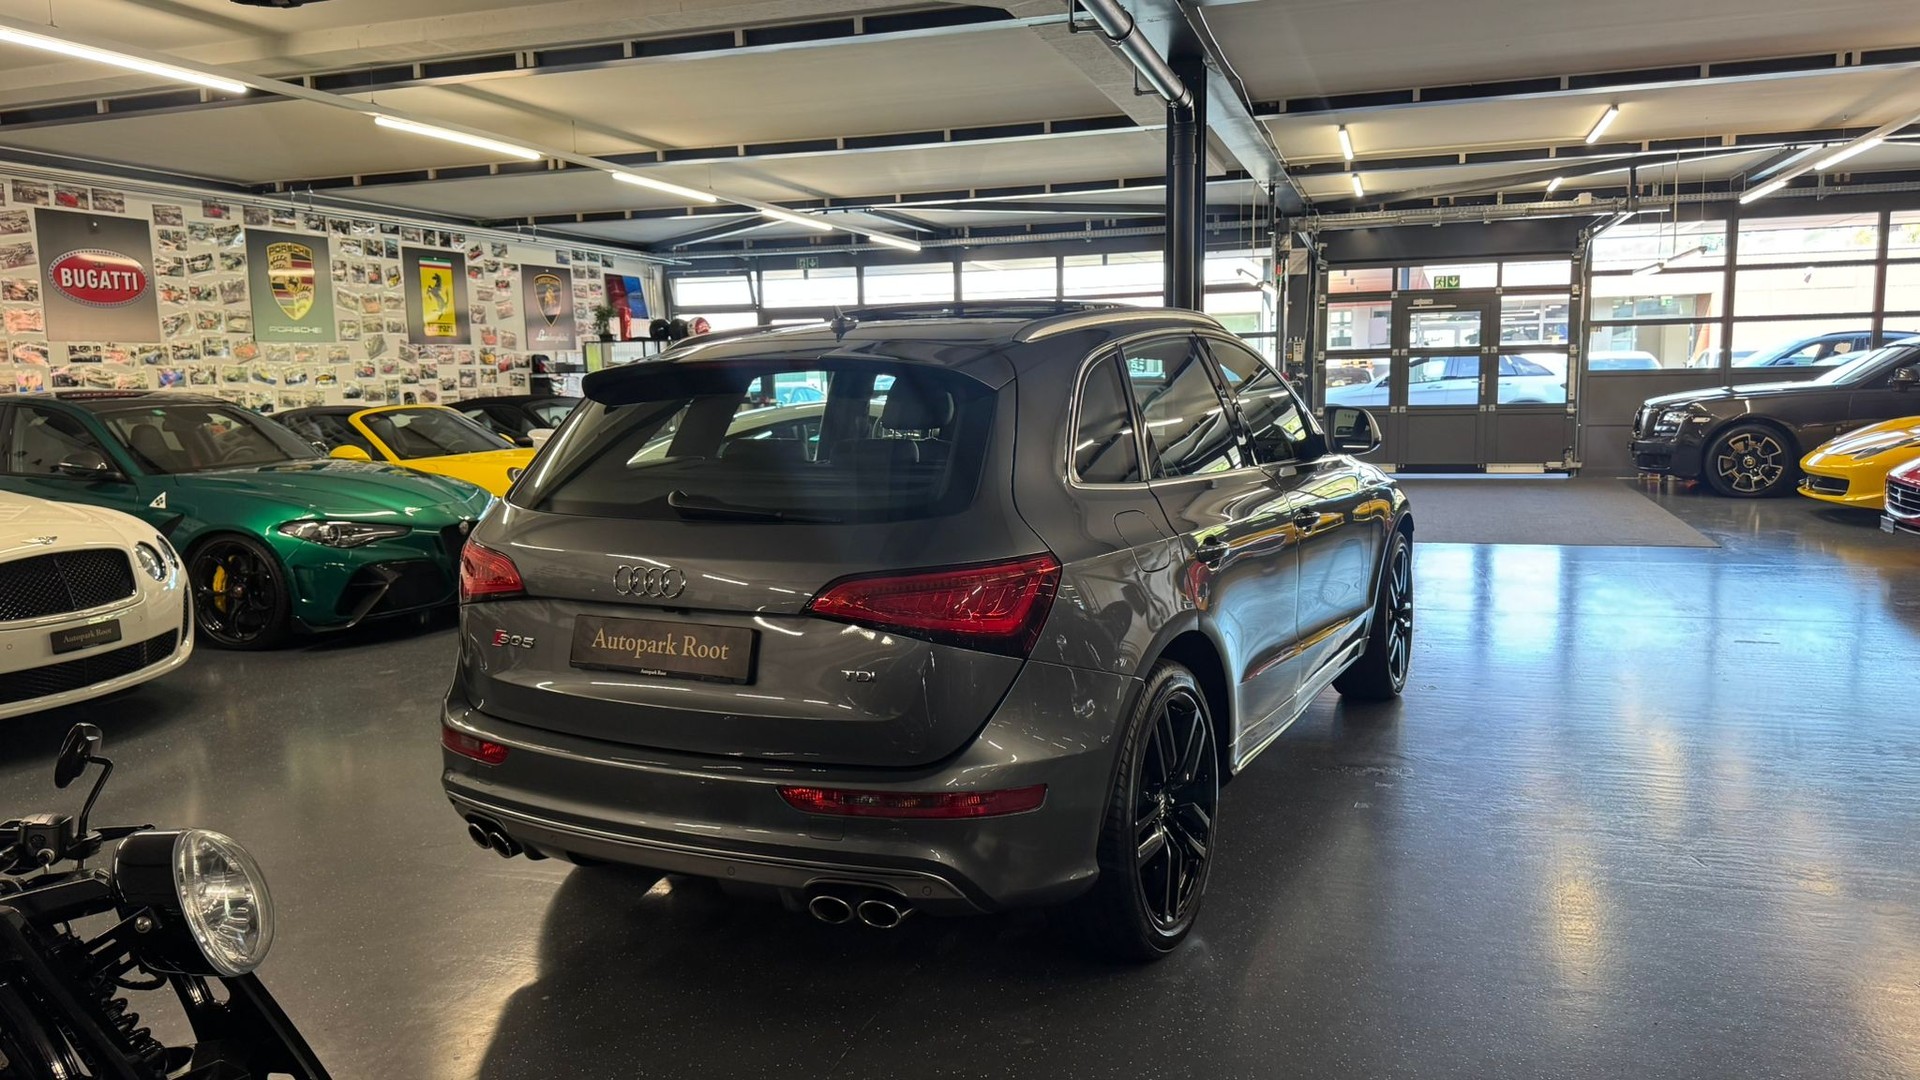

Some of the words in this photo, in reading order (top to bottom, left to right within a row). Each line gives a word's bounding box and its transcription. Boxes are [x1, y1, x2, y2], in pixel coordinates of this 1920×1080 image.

[60, 267, 139, 291] BUGATTI
[592, 627, 677, 659] Autopark
[681, 635, 729, 660] Root
[841, 669, 876, 681] TDI
